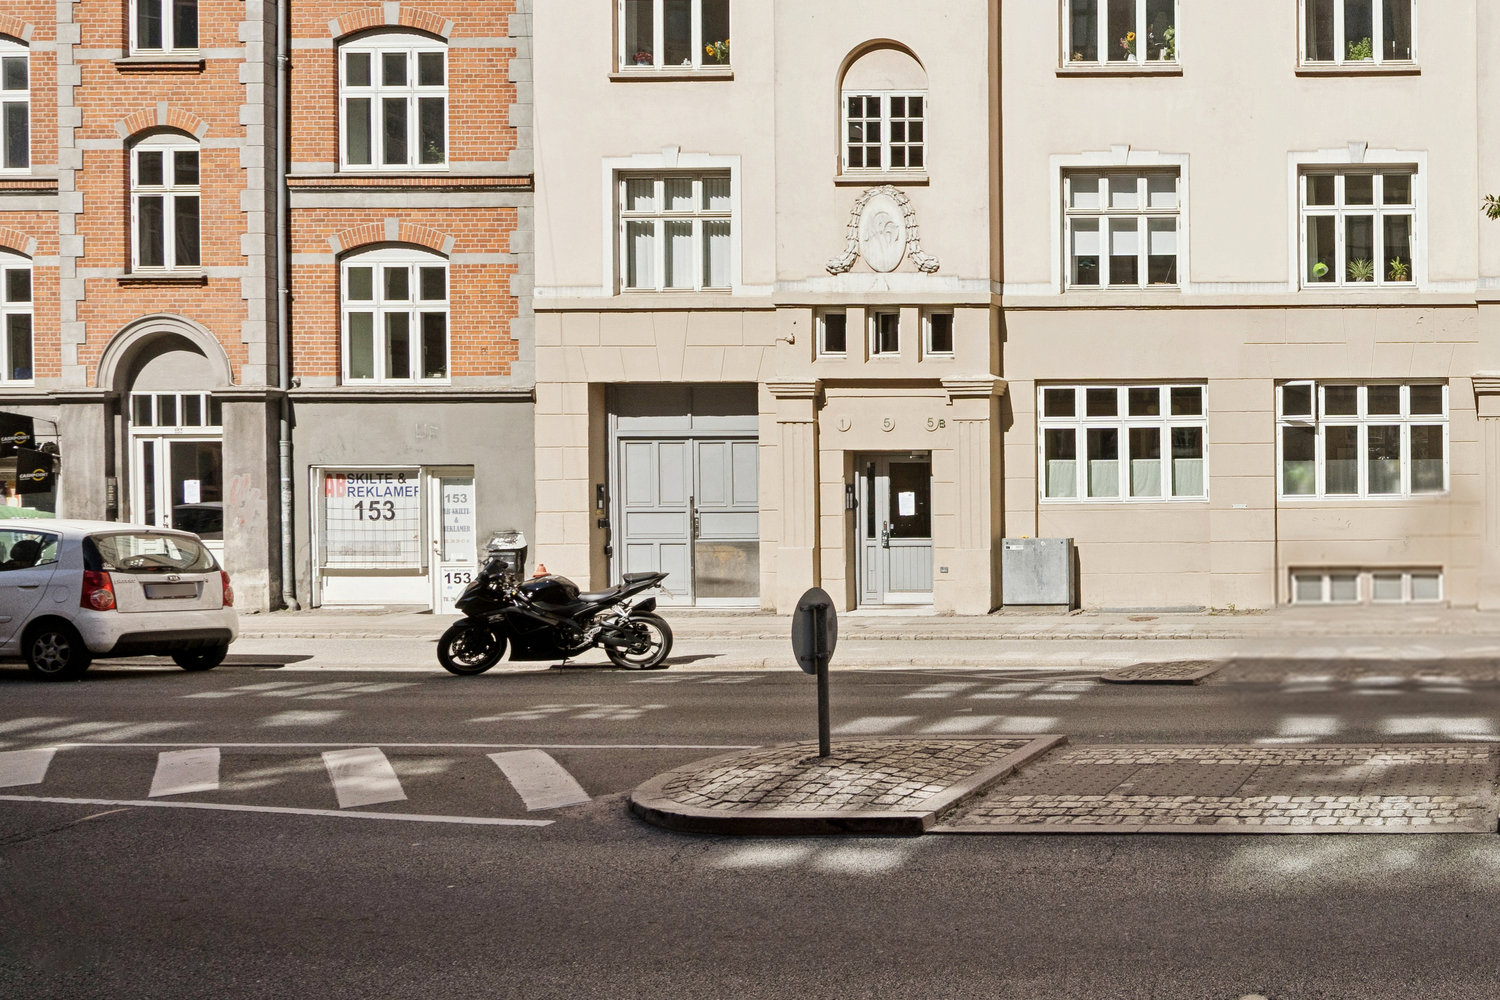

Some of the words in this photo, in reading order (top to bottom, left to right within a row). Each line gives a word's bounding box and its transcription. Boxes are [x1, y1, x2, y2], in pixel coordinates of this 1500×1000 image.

[324, 473, 346, 498] AB
[346, 472, 393, 485] SKILTE
[397, 472, 407, 485] &
[445, 493, 468, 503] 153
[354, 500, 396, 521] 153
[444, 572, 471, 584] 153
